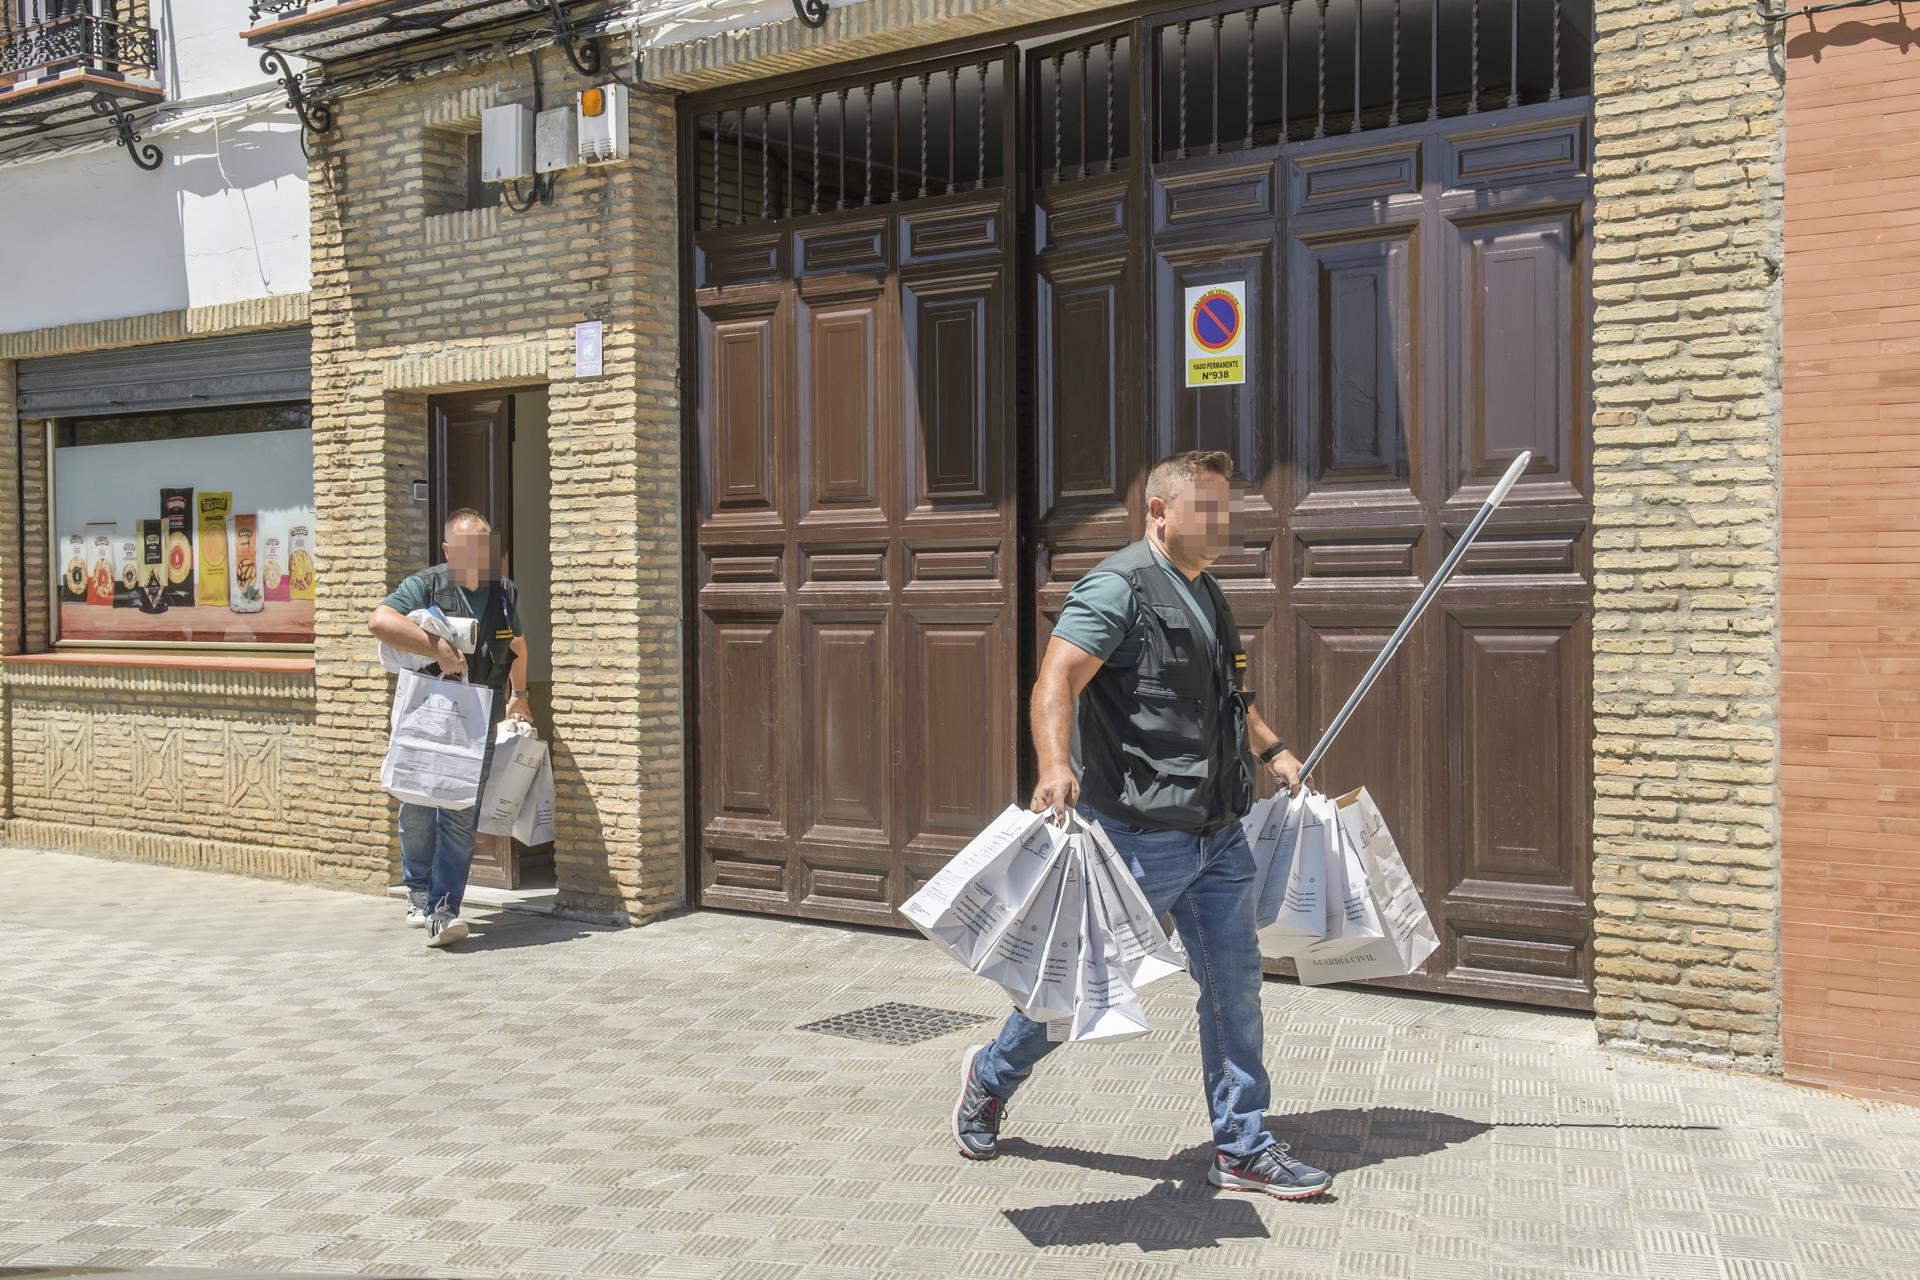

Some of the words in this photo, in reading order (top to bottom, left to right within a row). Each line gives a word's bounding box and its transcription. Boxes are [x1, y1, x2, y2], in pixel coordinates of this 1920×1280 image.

[1207, 361, 1238, 369] PERMANENTE
[1313, 958, 1351, 966] GUARDIA
[1350, 953, 1377, 962] CIVIL
